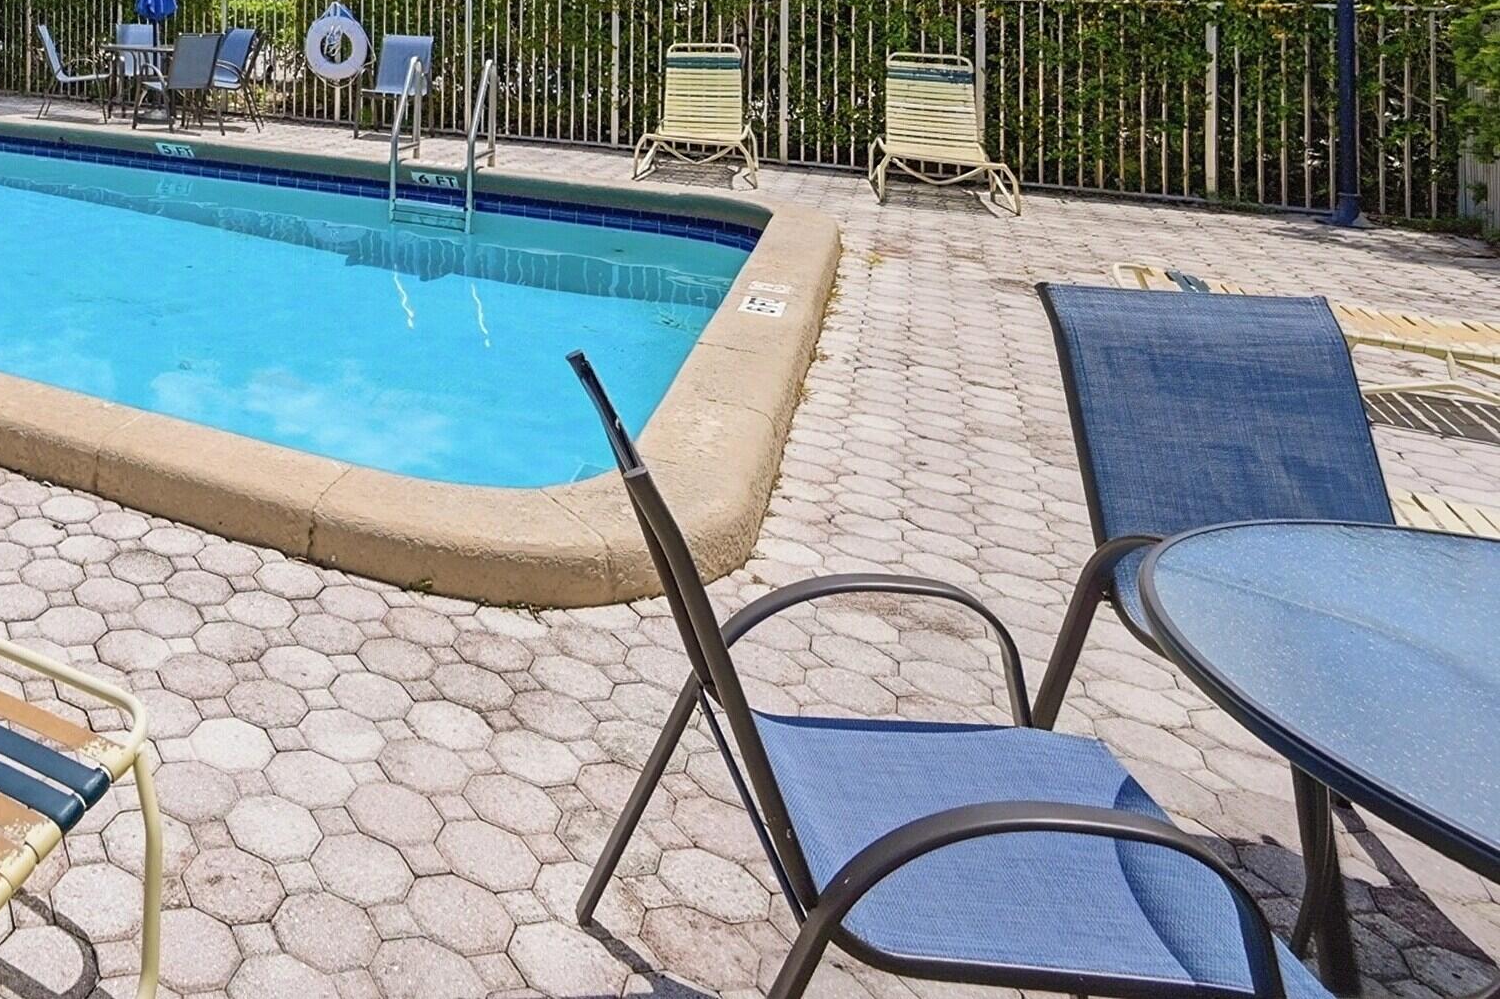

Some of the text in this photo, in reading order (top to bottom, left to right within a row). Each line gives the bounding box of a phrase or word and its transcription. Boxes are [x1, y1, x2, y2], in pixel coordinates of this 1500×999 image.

[161, 145, 191, 157] 5 FT
[418, 174, 455, 187] 6 FT
